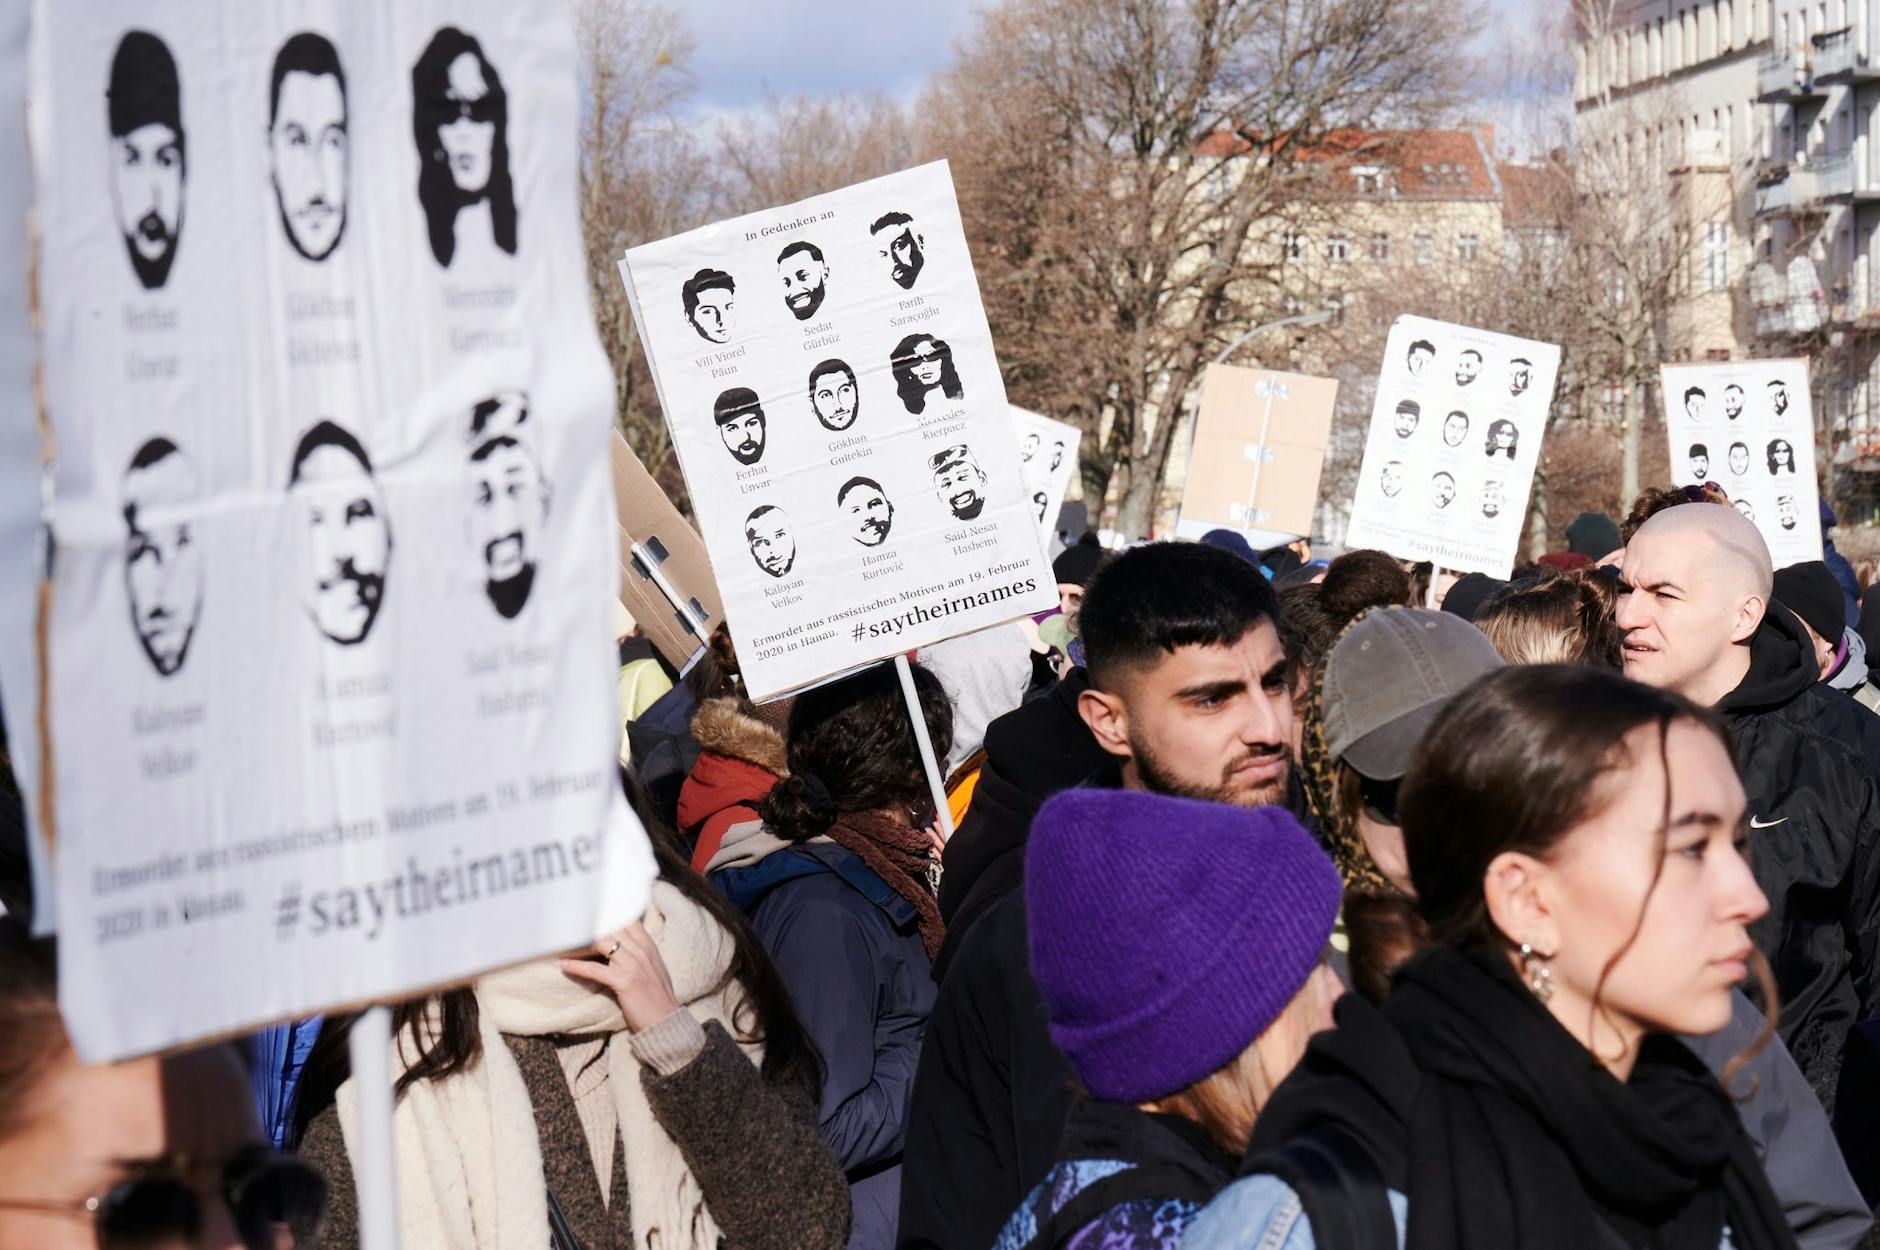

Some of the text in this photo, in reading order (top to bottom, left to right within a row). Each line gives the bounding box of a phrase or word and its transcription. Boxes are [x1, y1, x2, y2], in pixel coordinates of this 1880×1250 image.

[745, 210, 834, 241] In Gedenken an
[899, 295, 924, 311] Fatih
[804, 321, 832, 336] Sedat
[695, 346, 745, 370] Vili Viorel
[923, 421, 966, 441] Kierpacz
[829, 433, 867, 452] Gökhan
[736, 464, 768, 481] Ferhat
[740, 479, 772, 495] Unvar
[945, 521, 998, 544] Said Nesar
[953, 536, 998, 556] Hashemi
[862, 549, 897, 567] Hamza
[764, 577, 804, 598] Kaloyan
[753, 557, 1031, 648] Ermordet aus rassistischen Motiven am 19. Februar
[771, 593, 803, 610] Velkov
[852, 577, 1037, 643] #saytheirnames
[756, 630, 839, 662] 2020 in Hanau.
[273, 829, 604, 942] #saytheirname
